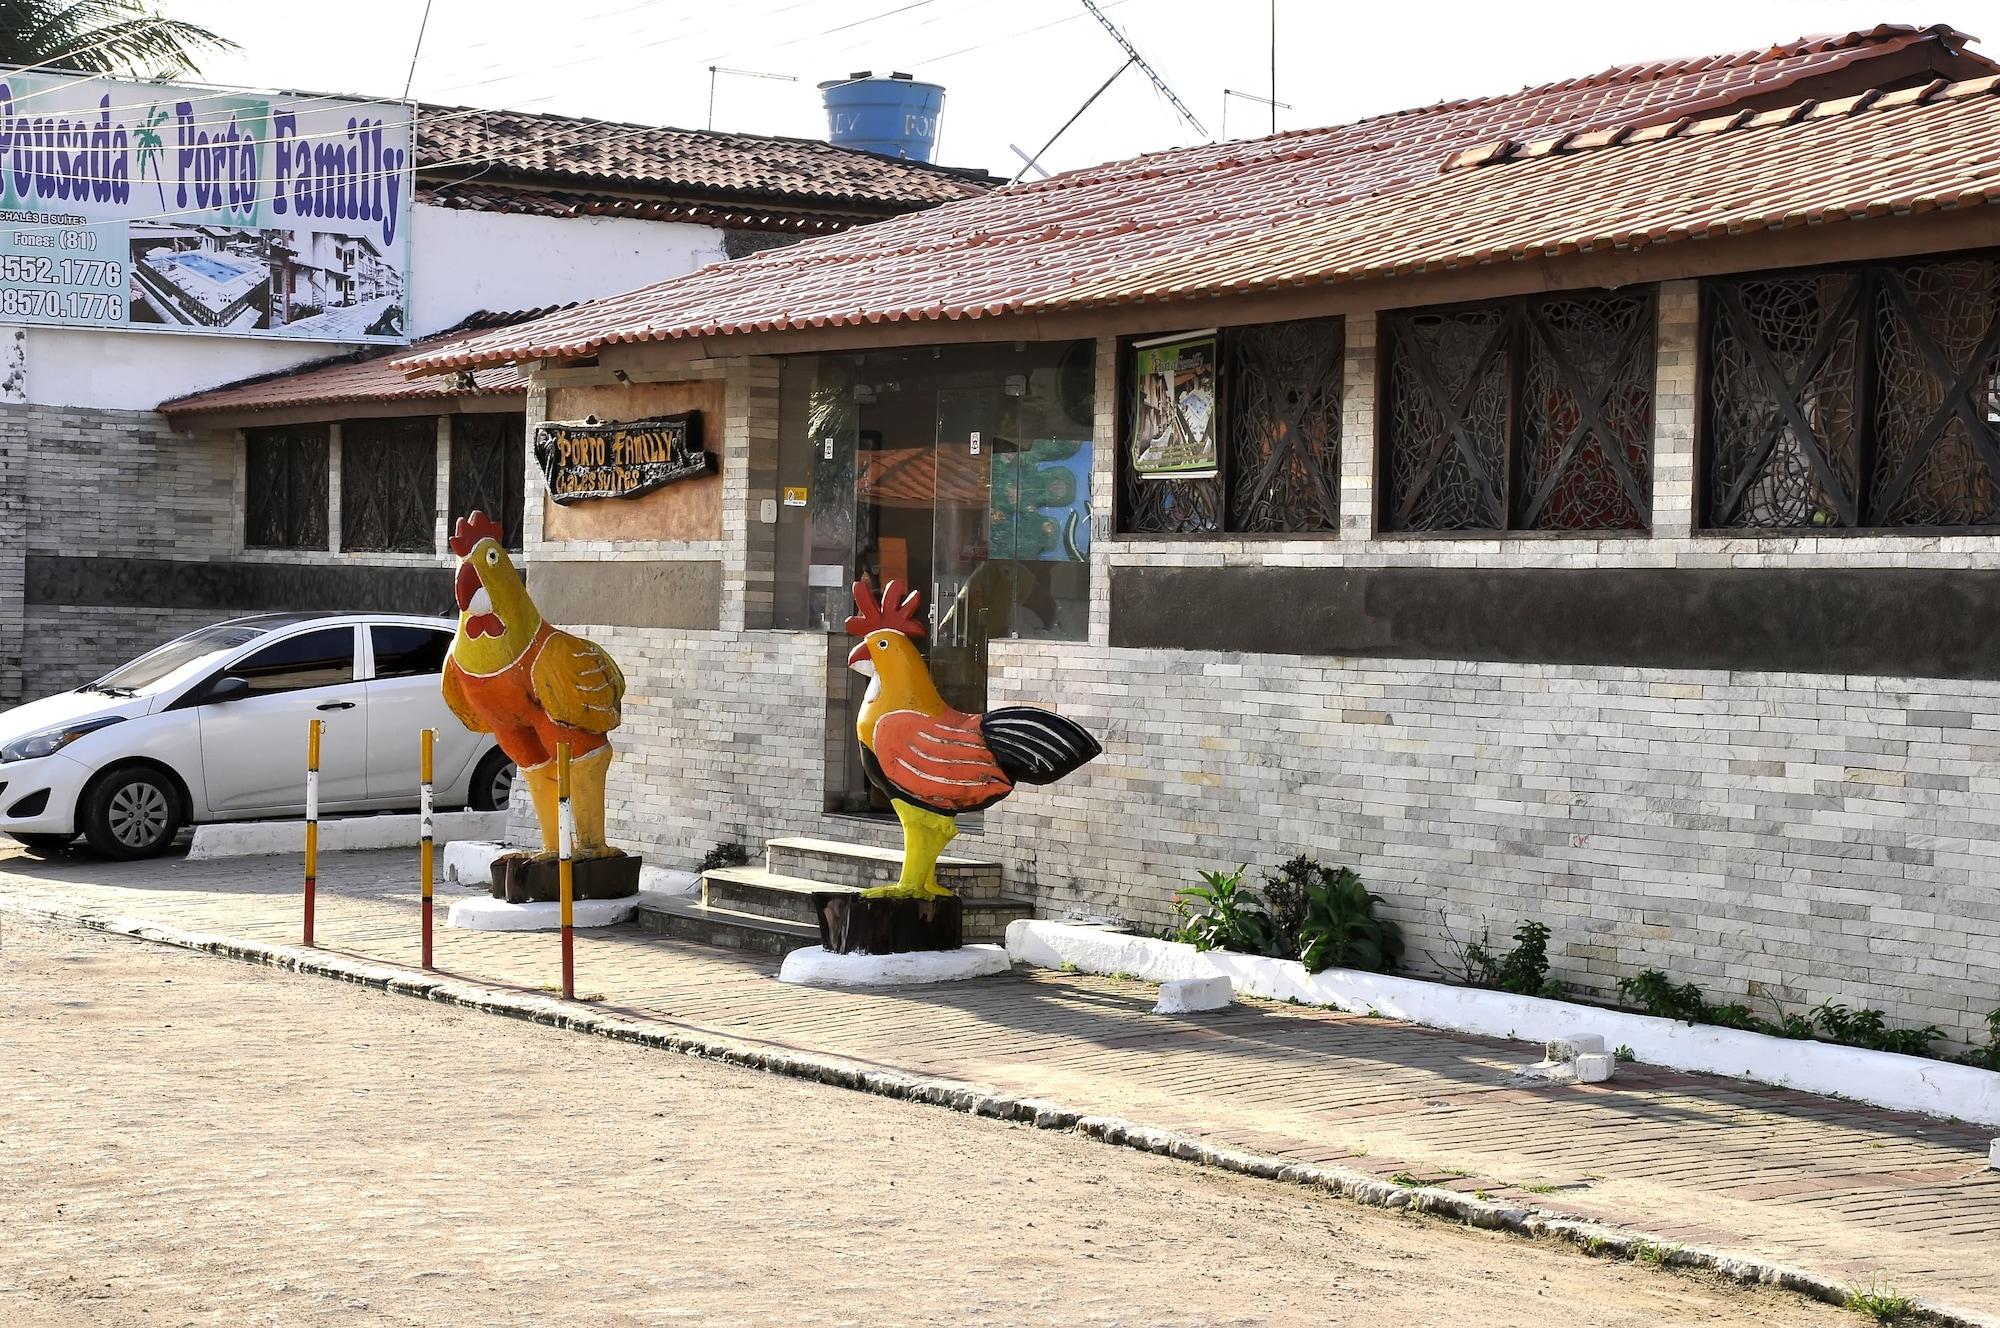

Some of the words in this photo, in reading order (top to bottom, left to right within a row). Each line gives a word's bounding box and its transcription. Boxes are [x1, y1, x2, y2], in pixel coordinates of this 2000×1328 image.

[176, 101, 256, 214] Porto
[273, 109, 404, 247] Familly
[41, 213, 49, 223] E
[14, 231, 54, 248] Fones:
[59, 229, 98, 252] (81)
[0, 287, 122, 321] 8570.1776
[556, 431, 606, 467] PORTO
